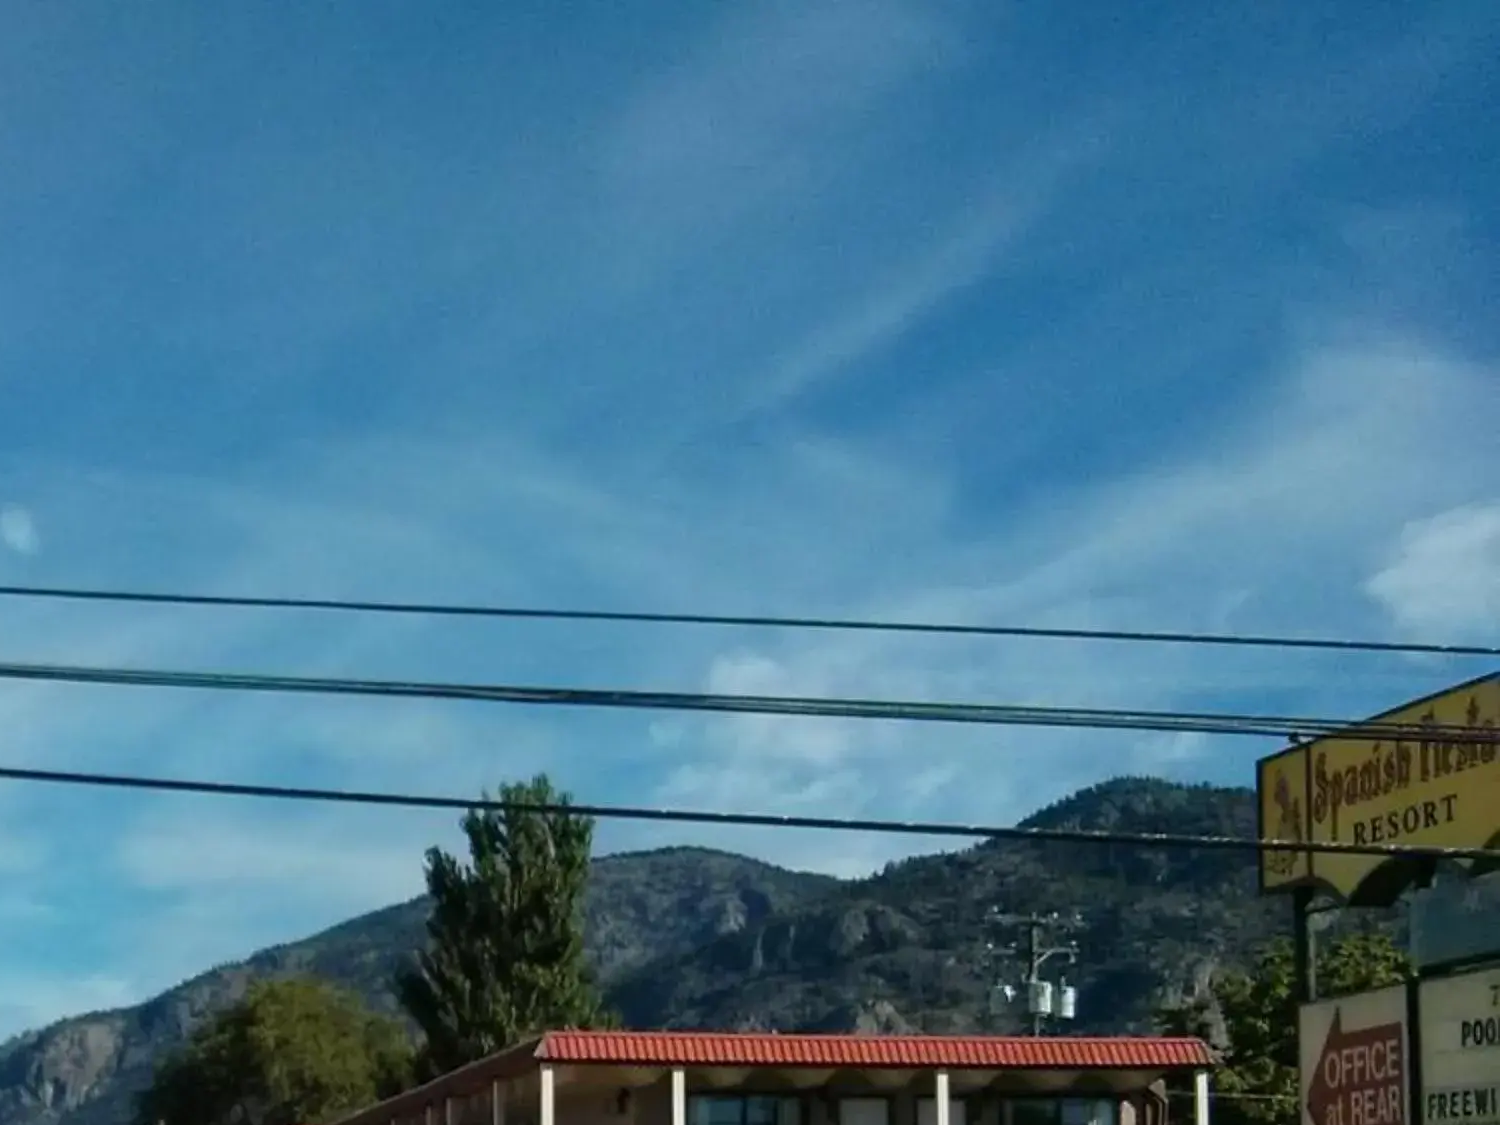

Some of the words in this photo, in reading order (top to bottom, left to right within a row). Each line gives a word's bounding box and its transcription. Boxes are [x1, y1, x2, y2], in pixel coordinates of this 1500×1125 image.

[1314, 738, 1411, 843] Spanish
[1352, 793, 1458, 845] RESORT
[1461, 1017, 1500, 1047] POO
[1324, 1039, 1400, 1089] OFFICE
